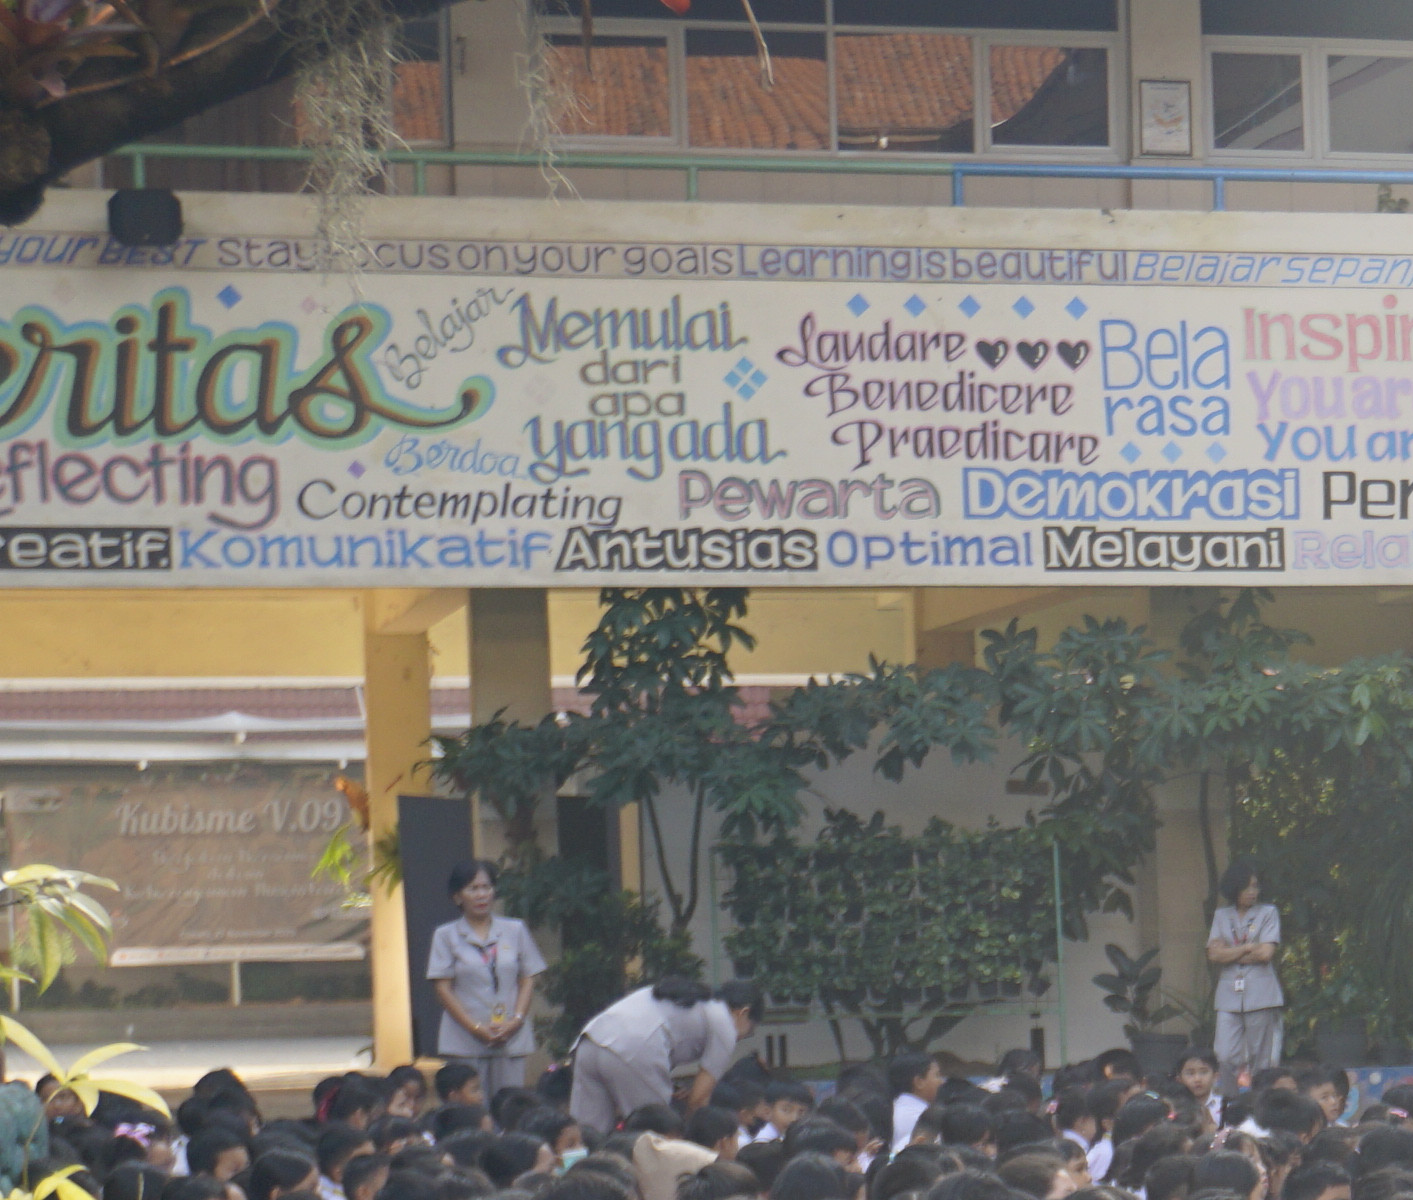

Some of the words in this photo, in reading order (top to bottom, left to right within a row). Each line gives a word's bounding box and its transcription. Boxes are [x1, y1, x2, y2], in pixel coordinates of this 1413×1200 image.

[331, 241, 449, 270] cus
[457, 243, 507, 271] on
[517, 244, 615, 275] your
[623, 245, 733, 276] goals
[739, 246, 912, 279] Learning
[916, 248, 946, 279] is
[950, 248, 1127, 281] beautiful
[1132, 252, 1283, 286] Belajar
[496, 291, 749, 369] Memulai
[776, 312, 968, 372] Laudare
[0, 300, 482, 440] ritas
[579, 350, 681, 385] dari
[1099, 319, 1230, 391] Bela
[588, 391, 686, 421] apa
[803, 370, 1075, 419] Benedicere
[1105, 395, 1231, 437] rasa
[1245, 369, 1342, 423] You
[523, 414, 665, 485] yang
[831, 419, 1101, 472] Praedicare
[1255, 423, 1357, 463] You
[0, 439, 280, 531] flecting
[295, 479, 623, 528] Contemplating
[677, 469, 942, 522] Pewarta
[965, 468, 1299, 521] Demokrasi
[0, 530, 169, 569] eatif.
[177, 528, 554, 571] Komunikatif
[555, 527, 818, 572] Antusias
[1045, 528, 1284, 571] Melayani
[1293, 529, 1411, 570] Rela
[115, 800, 257, 836] Kubisme
[263, 799, 344, 833] V.09
